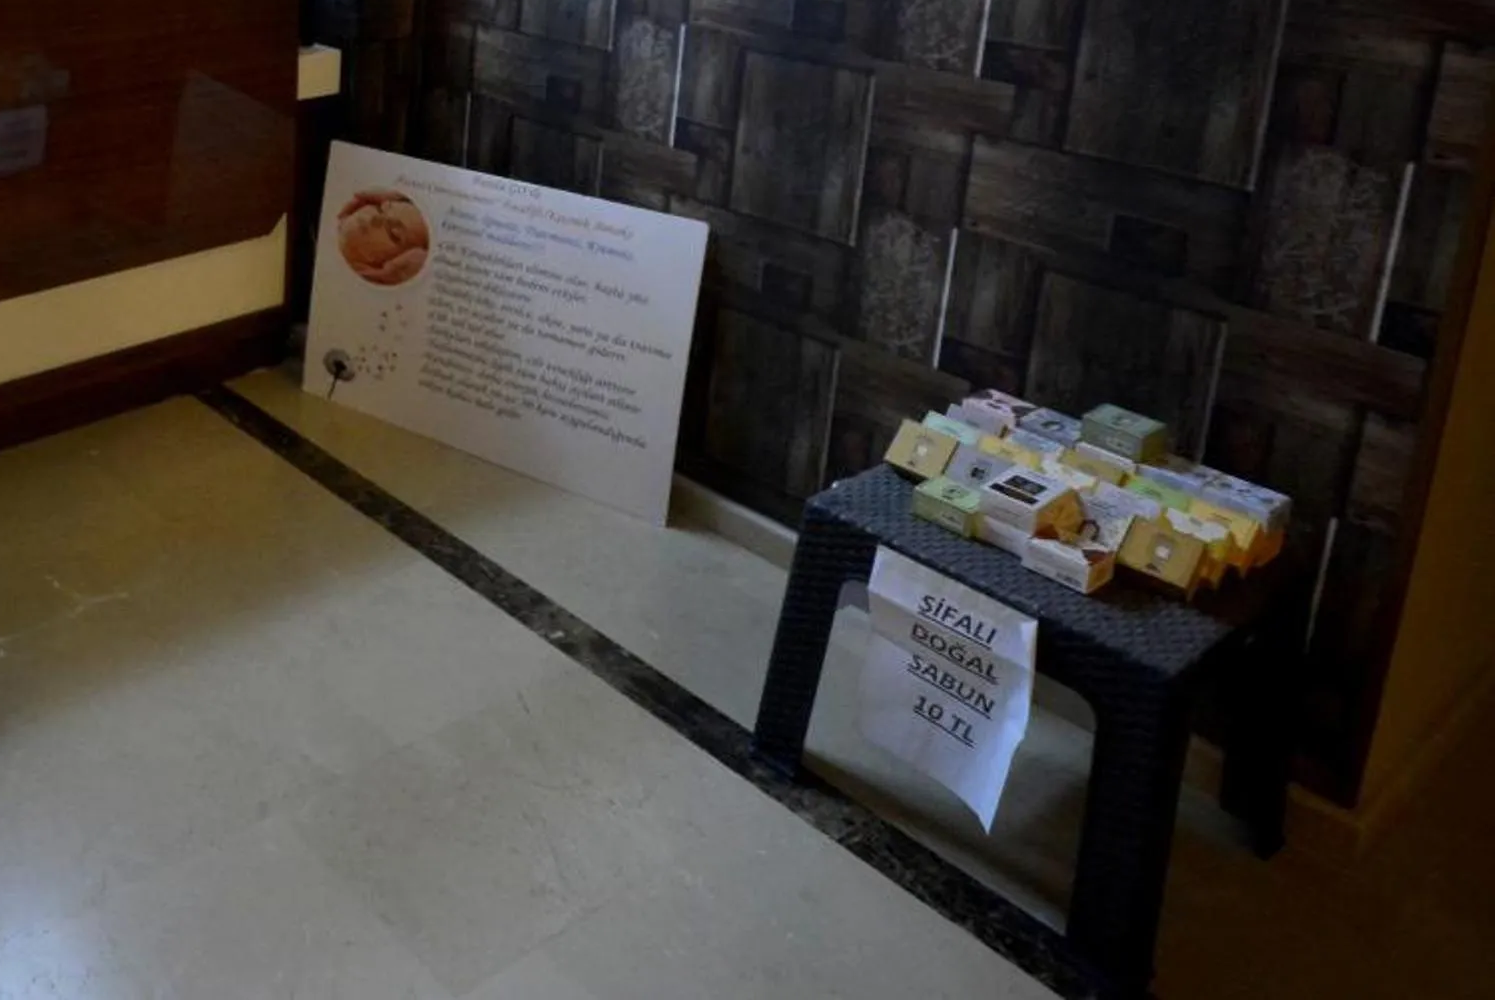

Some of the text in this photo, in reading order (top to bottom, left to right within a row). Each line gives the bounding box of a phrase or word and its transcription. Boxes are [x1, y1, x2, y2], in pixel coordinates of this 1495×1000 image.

[910, 621, 1001, 684] DOĞAL
[907, 653, 996, 717] SABUN
[912, 694, 977, 746] 10 TL
